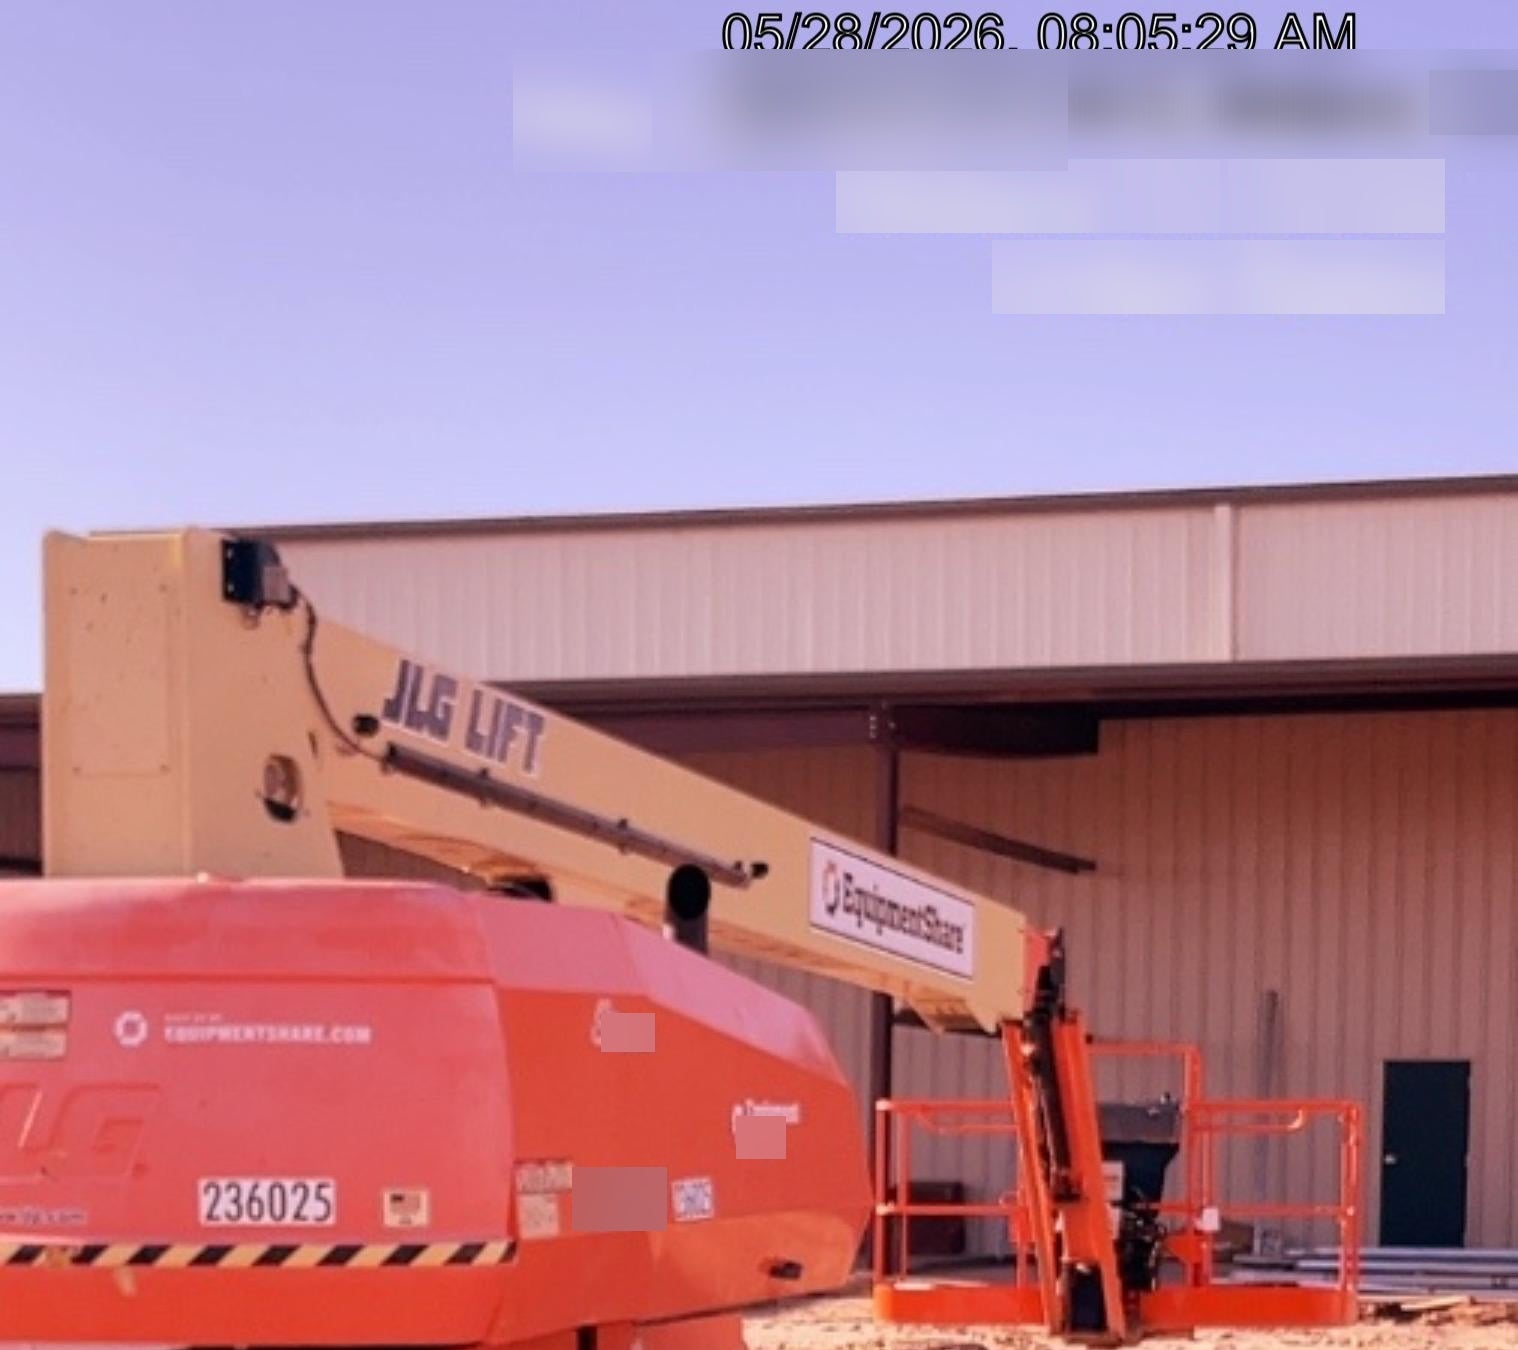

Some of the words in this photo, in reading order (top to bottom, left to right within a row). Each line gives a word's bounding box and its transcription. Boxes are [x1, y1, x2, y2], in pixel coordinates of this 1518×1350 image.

[383, 659, 457, 741] JLG
[465, 688, 544, 774] LIFT
[843, 871, 965, 955] EquipmentShare
[203, 1180, 332, 1222] 236025
